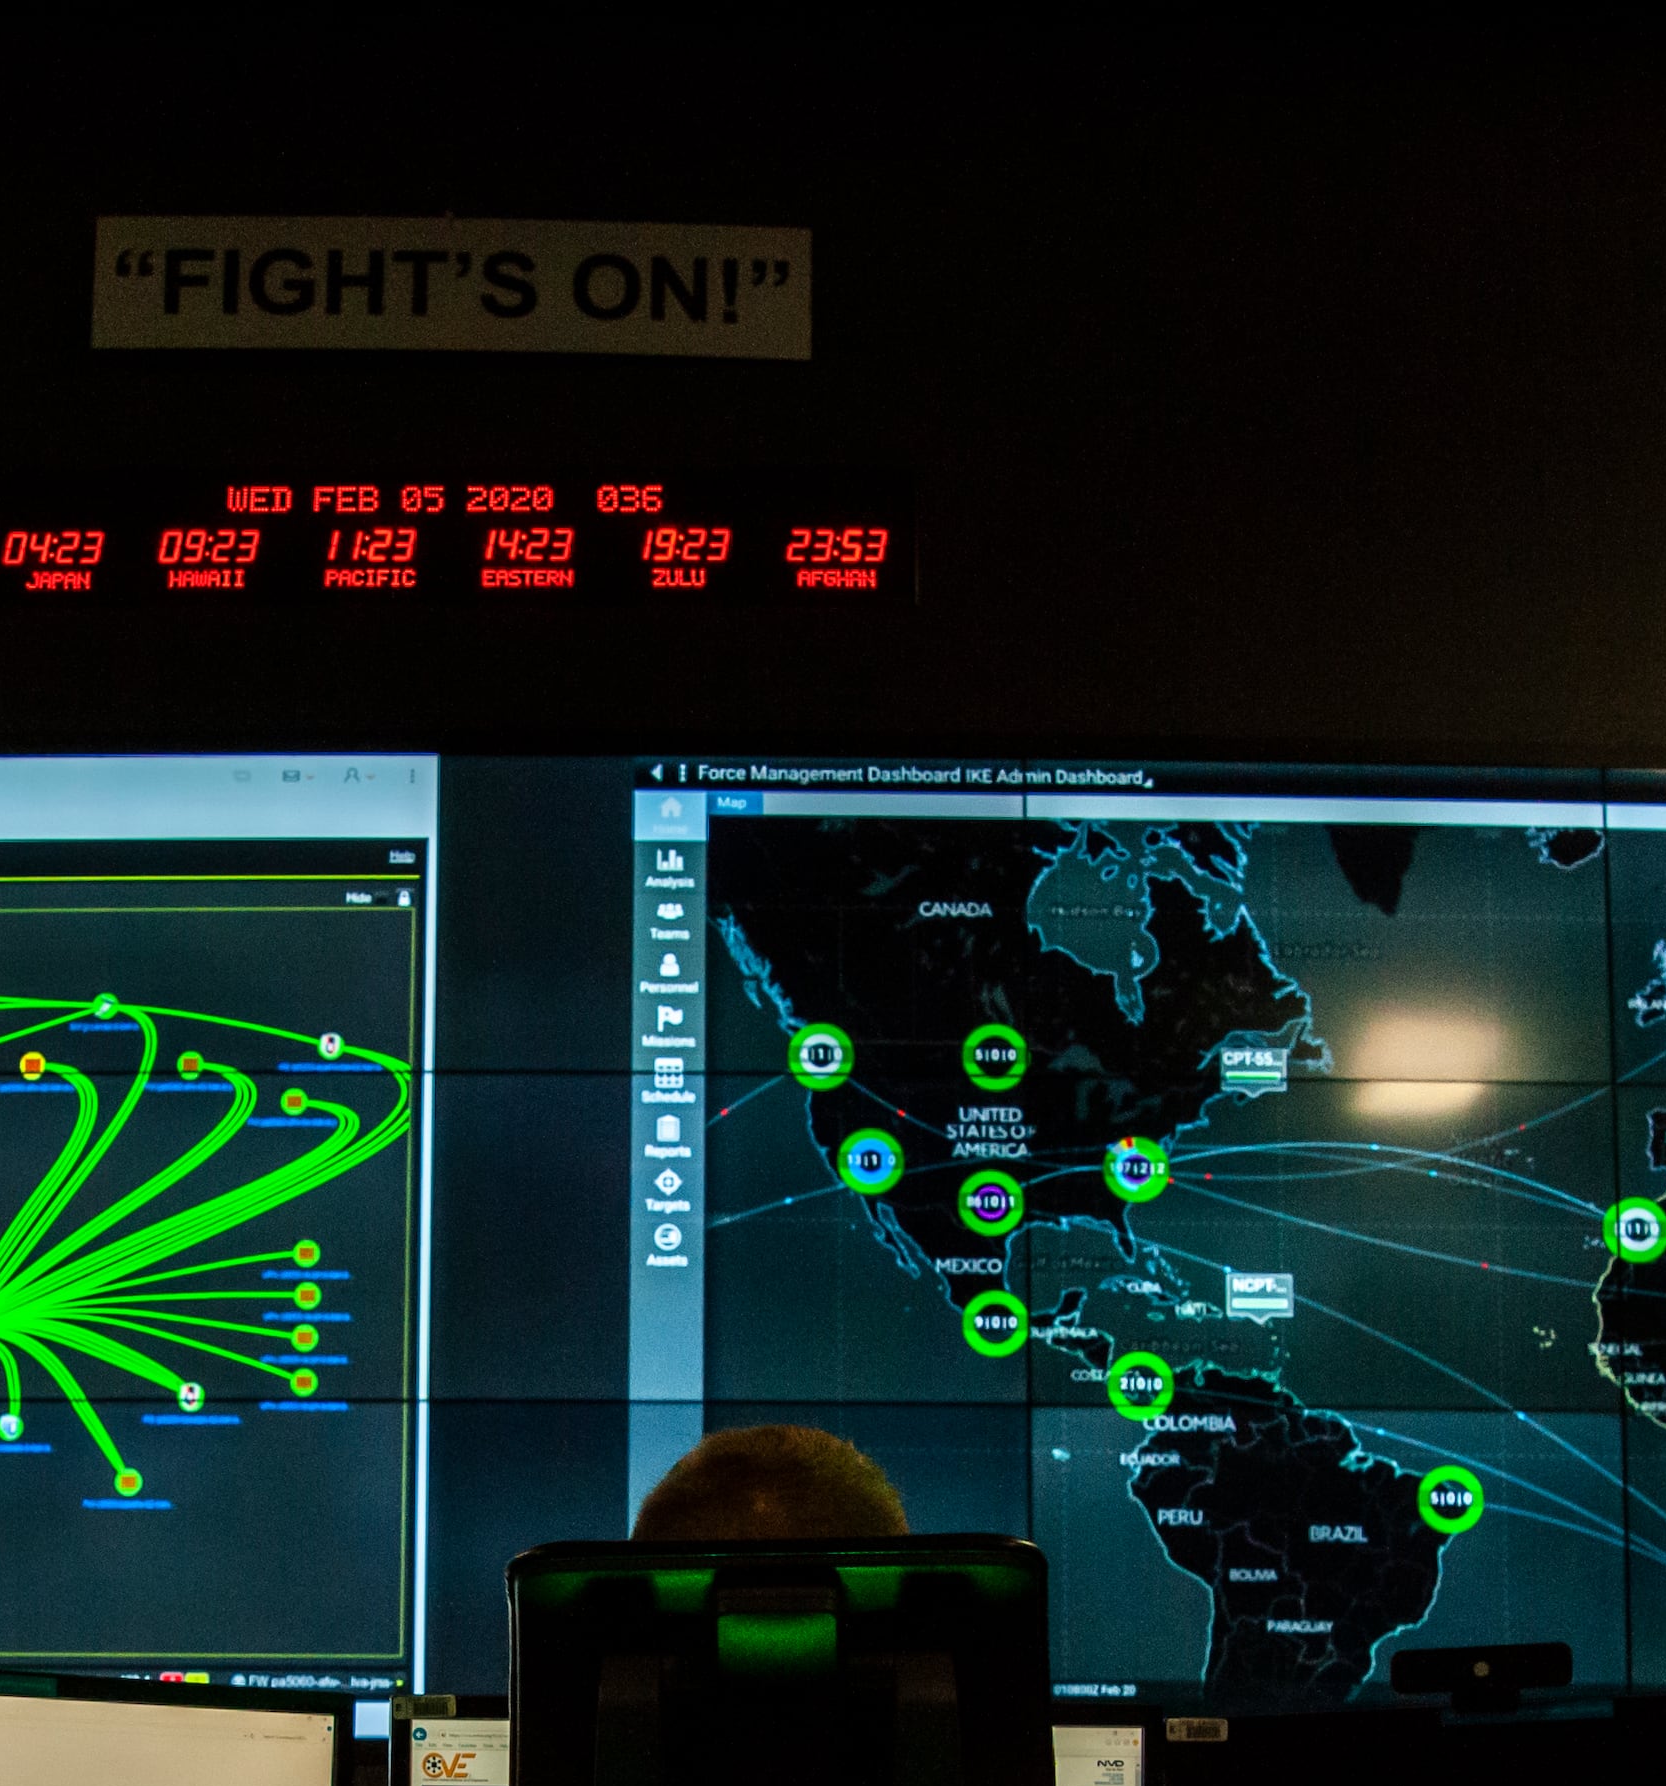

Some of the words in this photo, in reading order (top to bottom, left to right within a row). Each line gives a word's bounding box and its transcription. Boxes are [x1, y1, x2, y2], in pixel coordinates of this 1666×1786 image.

[572, 252, 791, 324] ON!”
[227, 485, 293, 513] WED
[313, 485, 379, 513] FEB
[401, 485, 446, 513] 05
[465, 484, 555, 512] 2020
[597, 484, 663, 512] 036
[2, 530, 105, 565] 04:23
[157, 528, 261, 565] 09:23
[327, 527, 417, 563] 11:23
[484, 527, 575, 562] 14:23
[642, 527, 732, 562] 19:23
[785, 528, 889, 563] 23:53
[25, 570, 92, 590] JAPAN
[167, 568, 245, 589] HAWAII
[323, 567, 418, 588] PACIFIC
[481, 567, 575, 588] EASTERN
[651, 567, 706, 588] ZULU
[796, 568, 878, 589] AFGHAN
[698, 764, 746, 781] Force
[750, 765, 864, 785] Management
[867, 766, 962, 783] Dashboard
[965, 768, 993, 784] IKE
[996, 768, 1052, 784] Admin
[1055, 768, 1144, 785] Dashboard
[717, 797, 747, 810] Map
[645, 876, 695, 889] Analysis
[918, 900, 994, 918] CANADA
[650, 927, 690, 940] Teams
[640, 981, 699, 993] Personnel
[642, 1035, 696, 1048] Missions
[641, 1090, 696, 1104] Schedule
[958, 1106, 1023, 1124] UNITED
[946, 1123, 1007, 1140] STATES
[644, 1144, 692, 1158] Reports
[951, 1141, 1030, 1159] AMERICA
[645, 1198, 691, 1213] Targets
[646, 1253, 689, 1267] Assets
[935, 1259, 1003, 1275] MEXICO
[1143, 1414, 1235, 1432] COLOMBIA
[1157, 1509, 1203, 1526] PERU
[1309, 1525, 1368, 1544] BRAZIL
[421, 1751, 477, 1778] CVE
[1096, 1759, 1125, 1768] NVD
